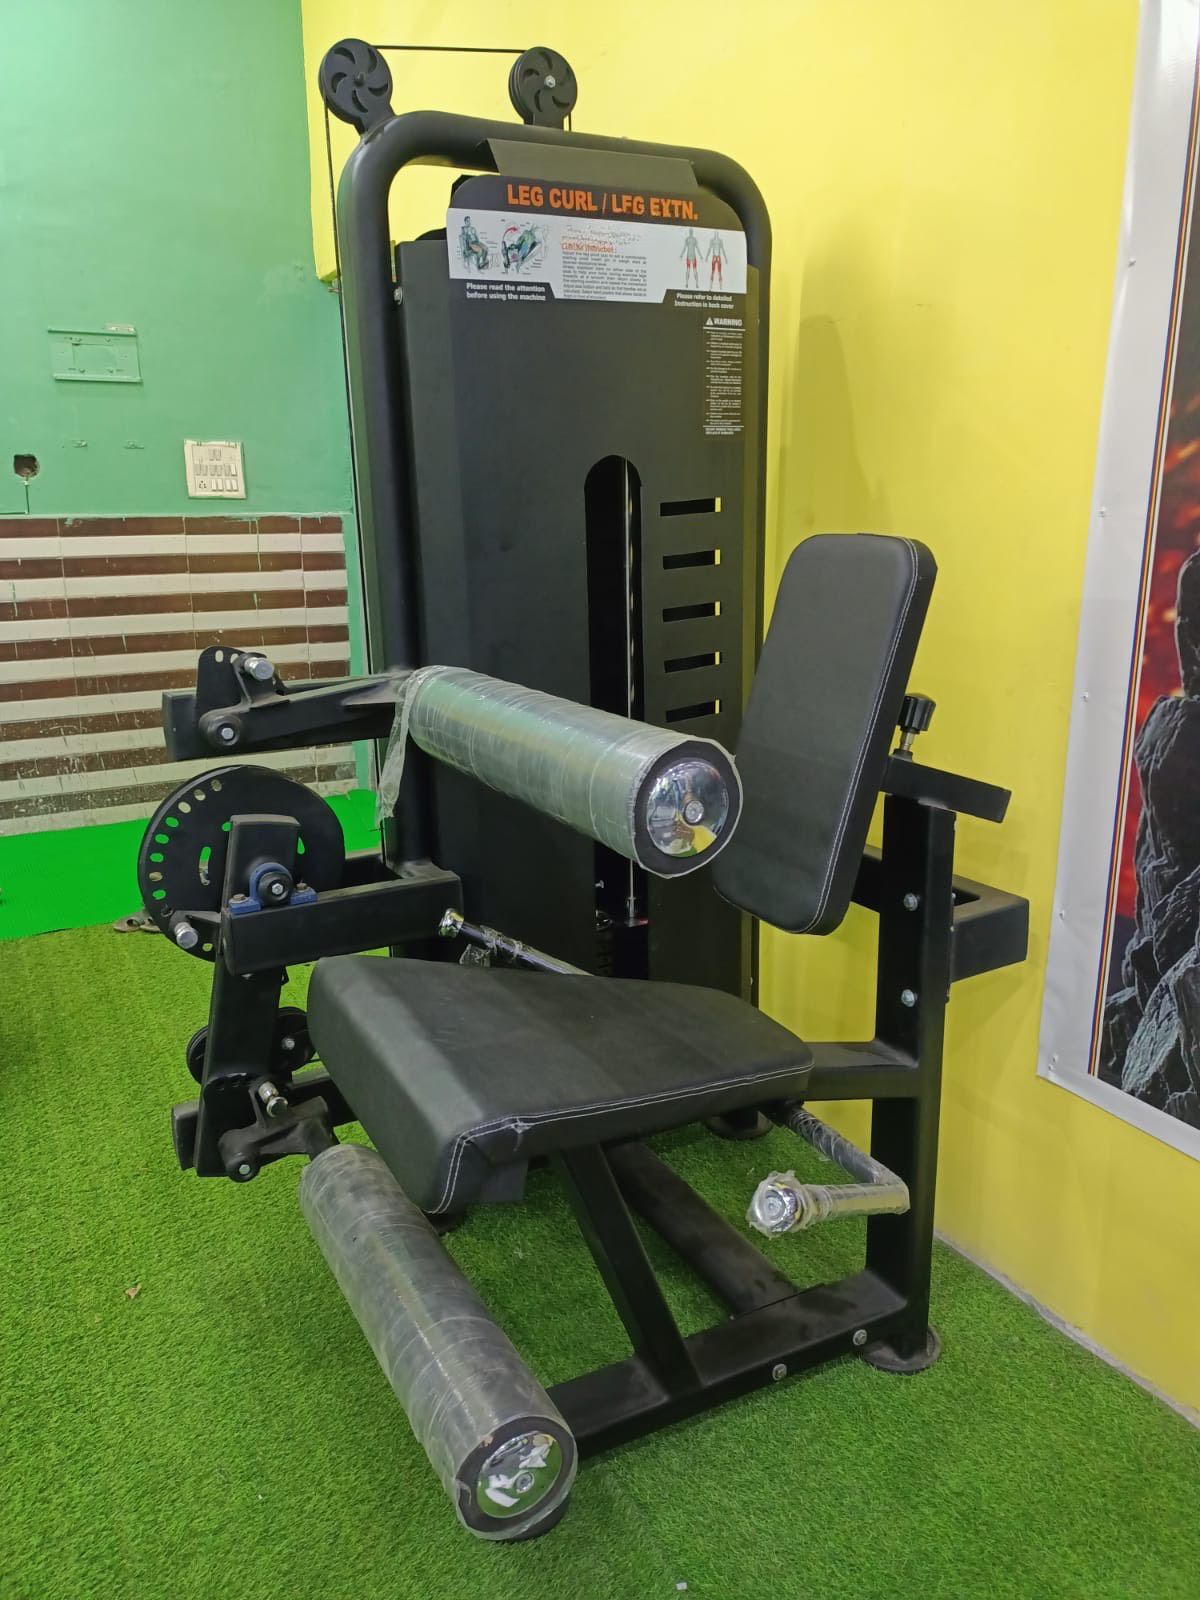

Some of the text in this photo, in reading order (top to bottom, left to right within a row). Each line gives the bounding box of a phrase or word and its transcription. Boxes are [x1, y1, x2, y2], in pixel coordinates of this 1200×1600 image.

[507, 184, 544, 207] LEG
[549, 187, 598, 211] CURL
[602, 192, 607, 214] /
[466, 282, 488, 290] Please
[489, 283, 504, 291] read
[466, 291, 488, 299] before
[489, 292, 507, 301] using
[519, 293, 546, 301] machine
[713, 317, 743, 326] WARNING
